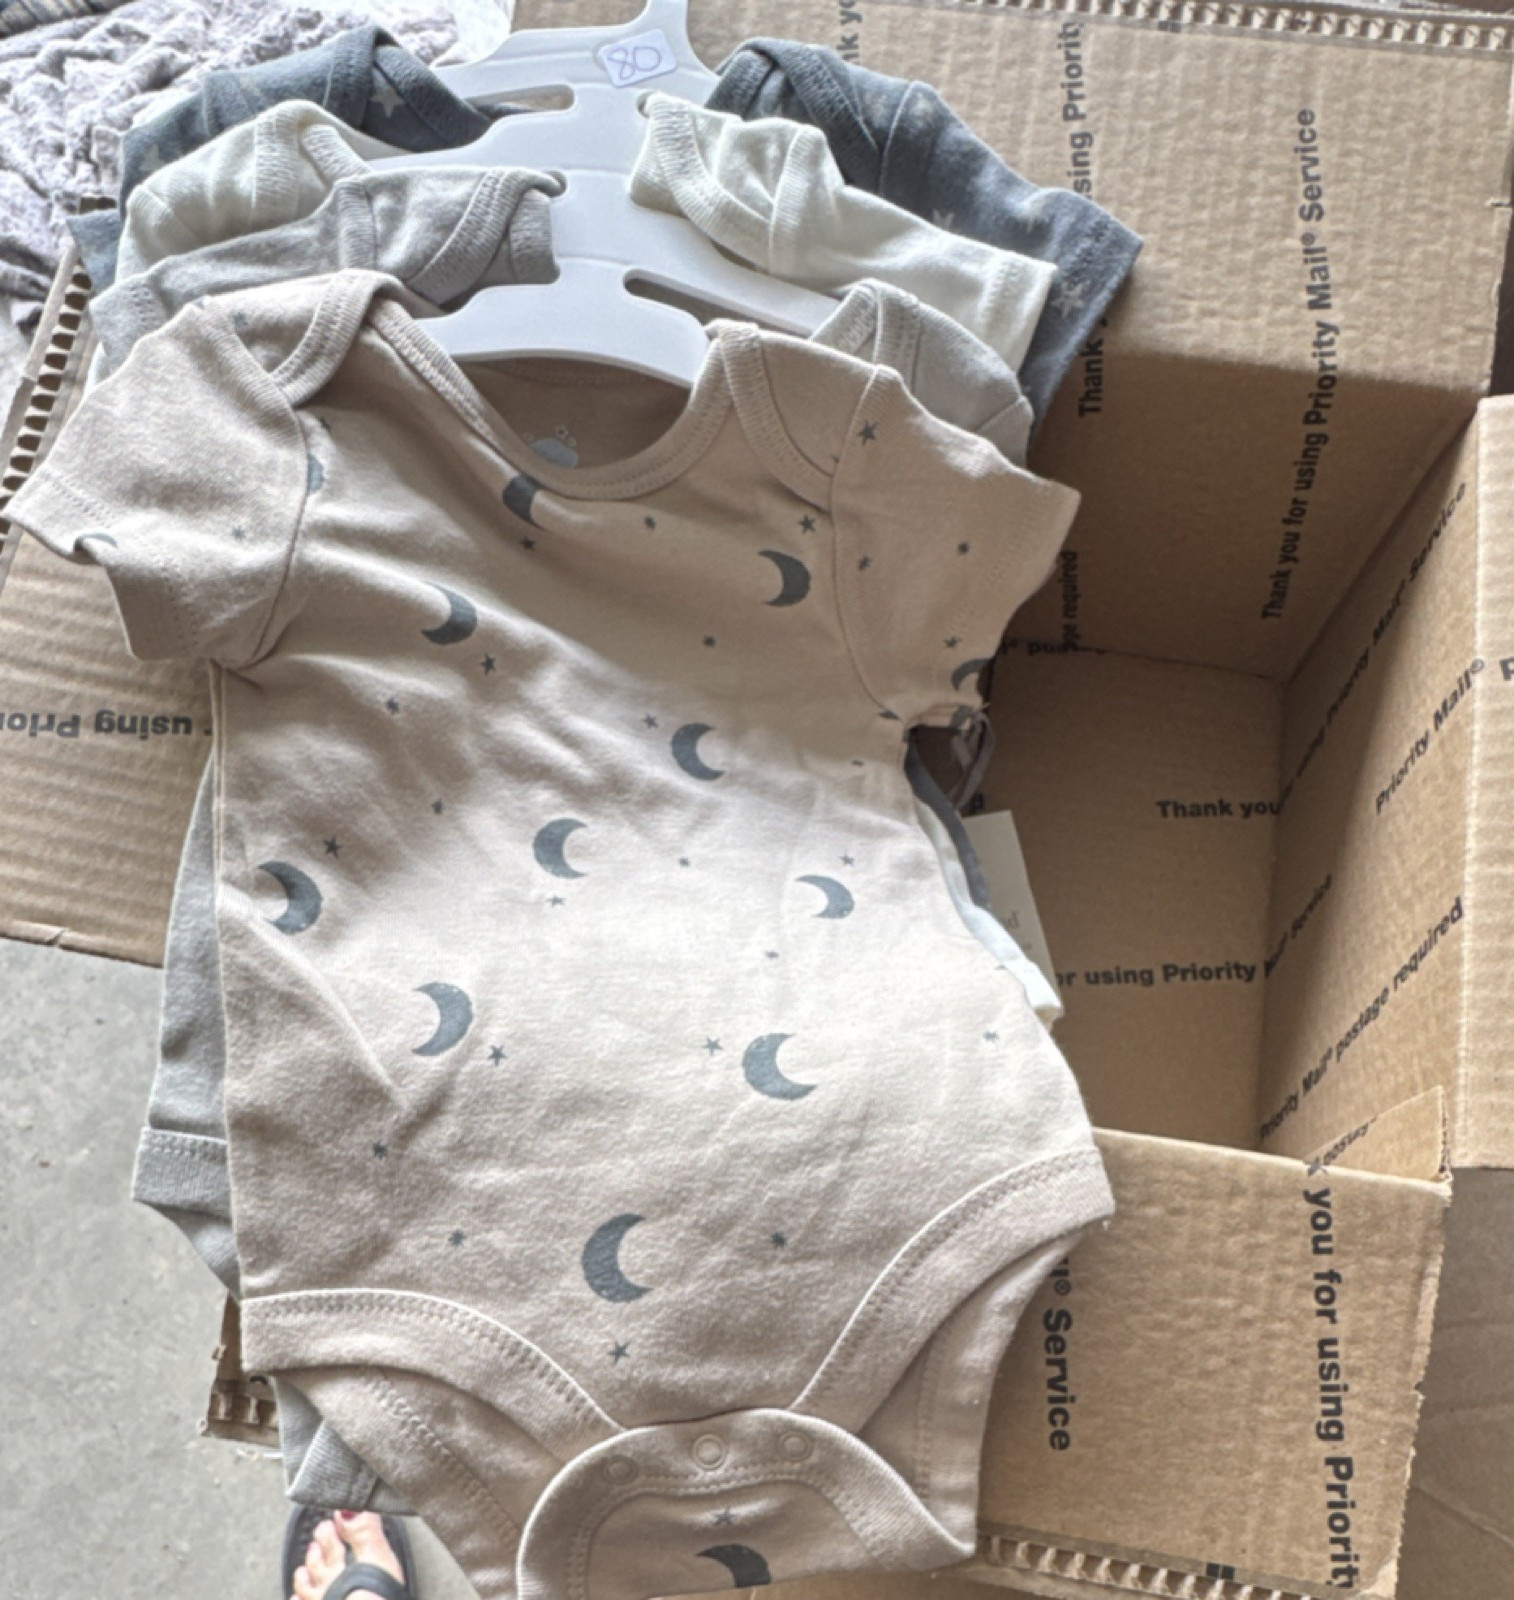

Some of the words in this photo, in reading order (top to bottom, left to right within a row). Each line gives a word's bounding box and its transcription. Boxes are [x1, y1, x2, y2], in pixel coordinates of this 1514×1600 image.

[607, 46, 662, 80] 80
[1066, 131, 1094, 200] sing
[1294, 108, 1325, 222] Service
[1078, 337, 1104, 418] Thank
[1303, 321, 1341, 425] Priority
[1294, 432, 1329, 492] using
[1282, 498, 1308, 526] for
[1410, 483, 1466, 583] Service
[1278, 531, 1300, 566] you
[1261, 568, 1292, 620] Thank
[0, 710, 81, 738] Prio
[93, 708, 193, 740] using
[1376, 728, 1430, 816] Priority
[1155, 798, 1233, 819] Thank
[1239, 800, 1281, 820] you
[1085, 965, 1155, 987] using
[1161, 959, 1257, 984] Priority
[1335, 984, 1390, 1063] postage
[1393, 896, 1464, 992] required
[1302, 1187, 1334, 1256] you
[1313, 1268, 1343, 1325] for
[1043, 1307, 1077, 1451] Service
[1315, 1337, 1350, 1442] using
